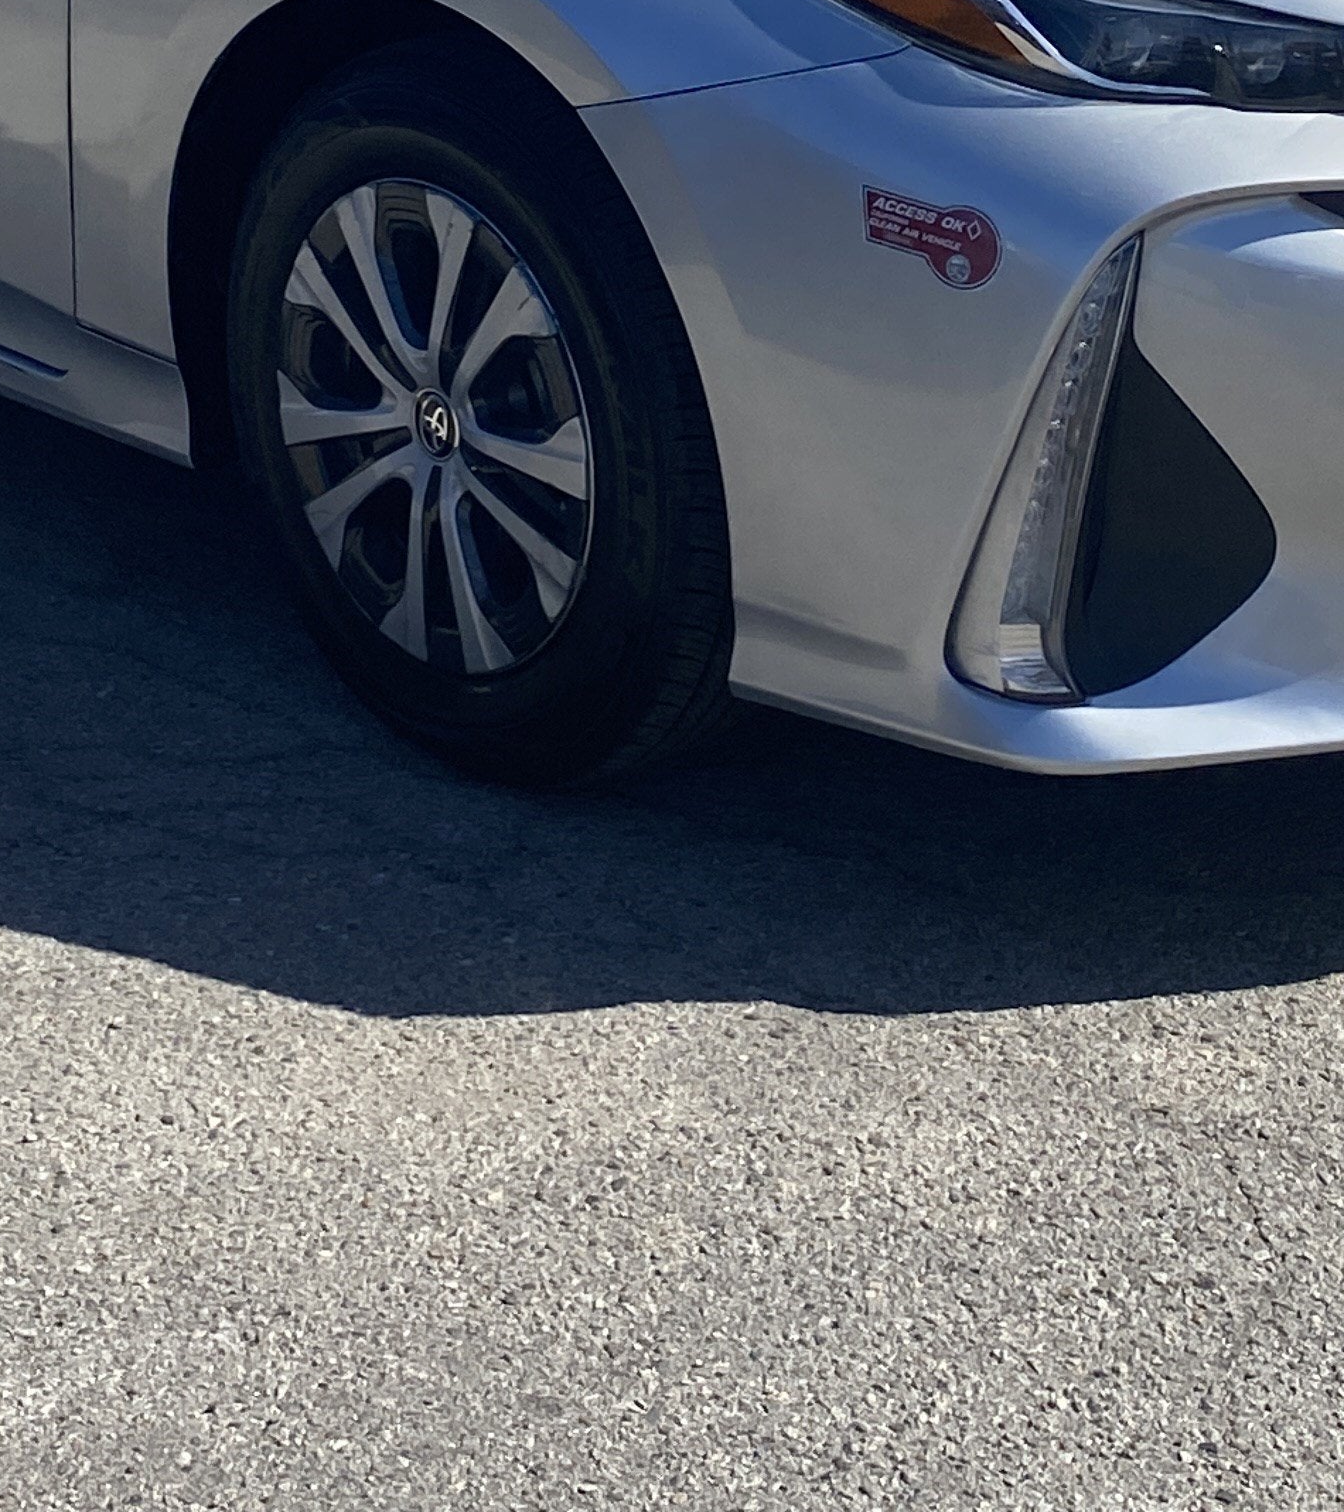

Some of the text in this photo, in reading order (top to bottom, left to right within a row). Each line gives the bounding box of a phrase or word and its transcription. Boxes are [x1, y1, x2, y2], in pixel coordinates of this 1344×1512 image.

[868, 217, 902, 234] CLEAN
[872, 196, 939, 225] ACCESS
[941, 215, 968, 234] OK
